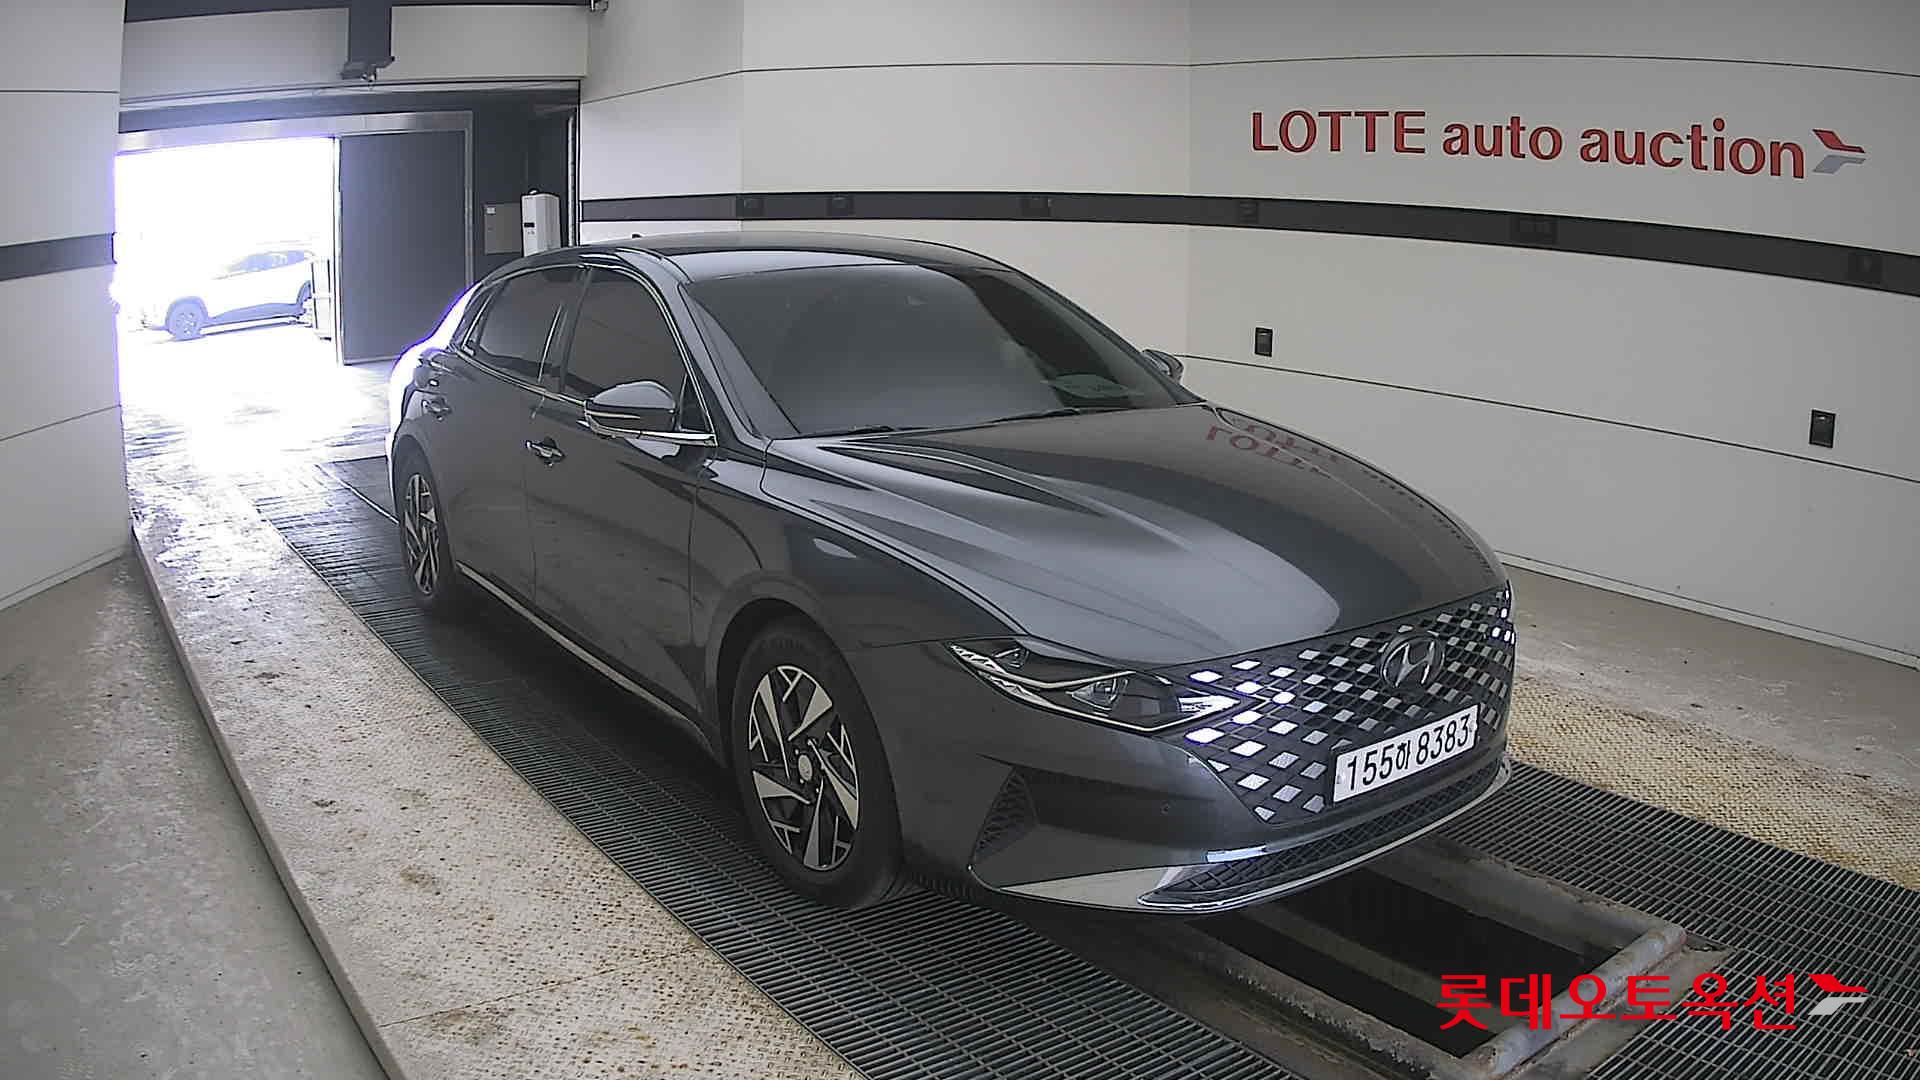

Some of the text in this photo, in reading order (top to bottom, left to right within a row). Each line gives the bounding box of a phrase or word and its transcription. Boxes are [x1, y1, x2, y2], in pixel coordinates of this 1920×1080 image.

[1252, 110, 1806, 180] LOTTE auto auction
[1416, 714, 1471, 765] 8383
